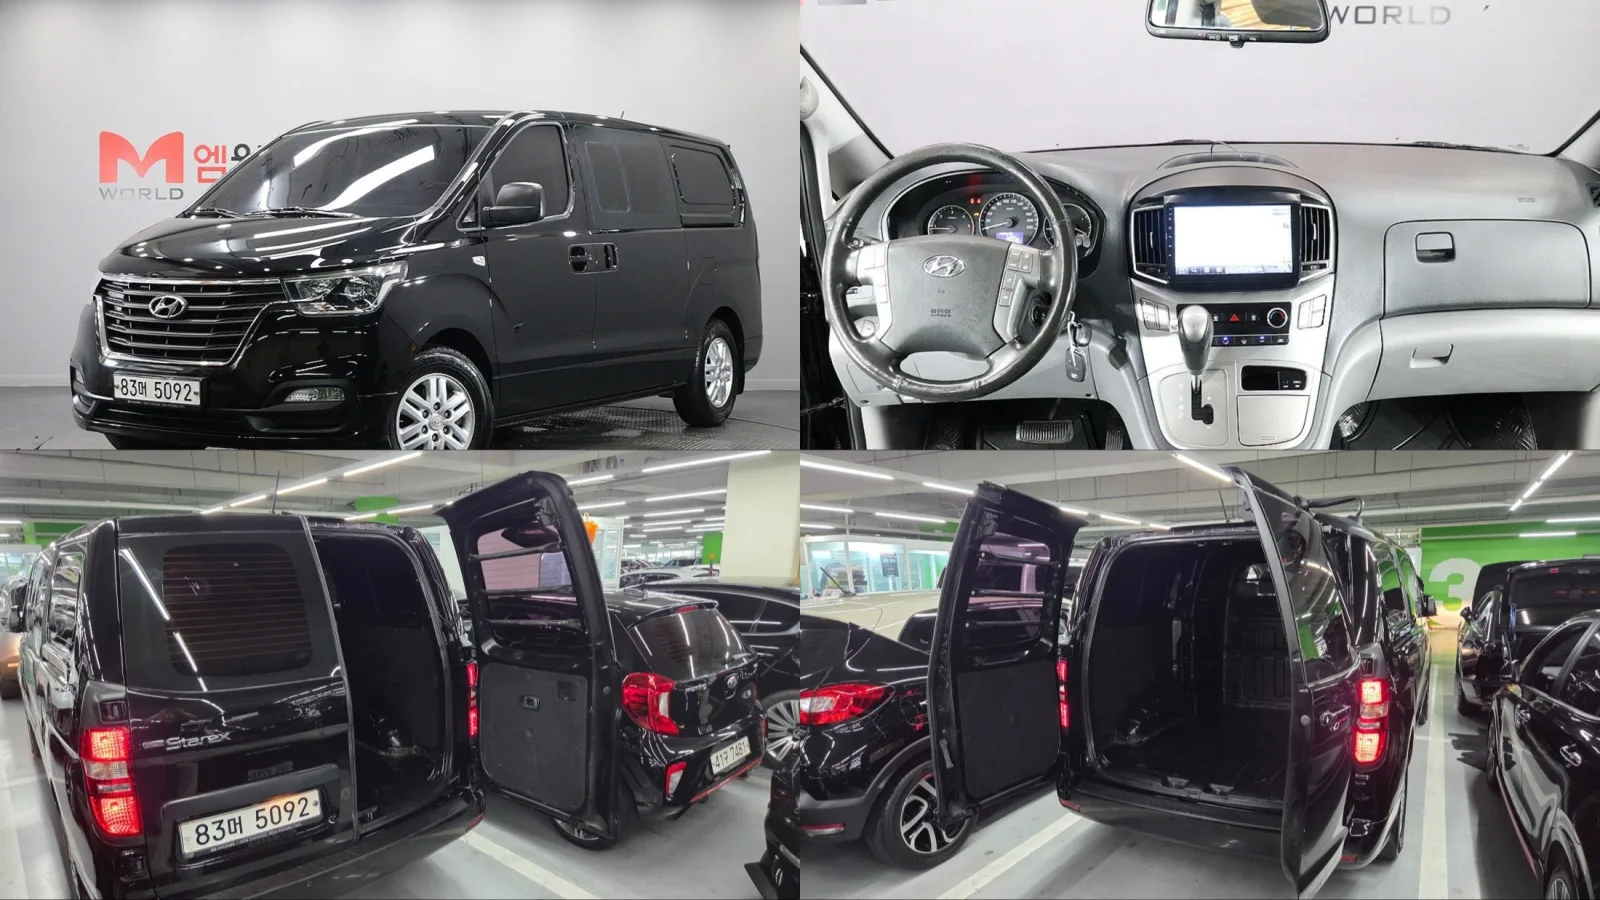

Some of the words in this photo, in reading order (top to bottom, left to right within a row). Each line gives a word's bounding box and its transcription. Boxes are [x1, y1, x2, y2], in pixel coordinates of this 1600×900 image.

[1327, 5, 1451, 25] WORLD
[99, 187, 184, 201] WORLD
[120, 378, 147, 397] 83머
[154, 381, 192, 402] 5092
[166, 731, 231, 751] Starex
[195, 816, 243, 846] 83머
[255, 797, 310, 829] 5092
